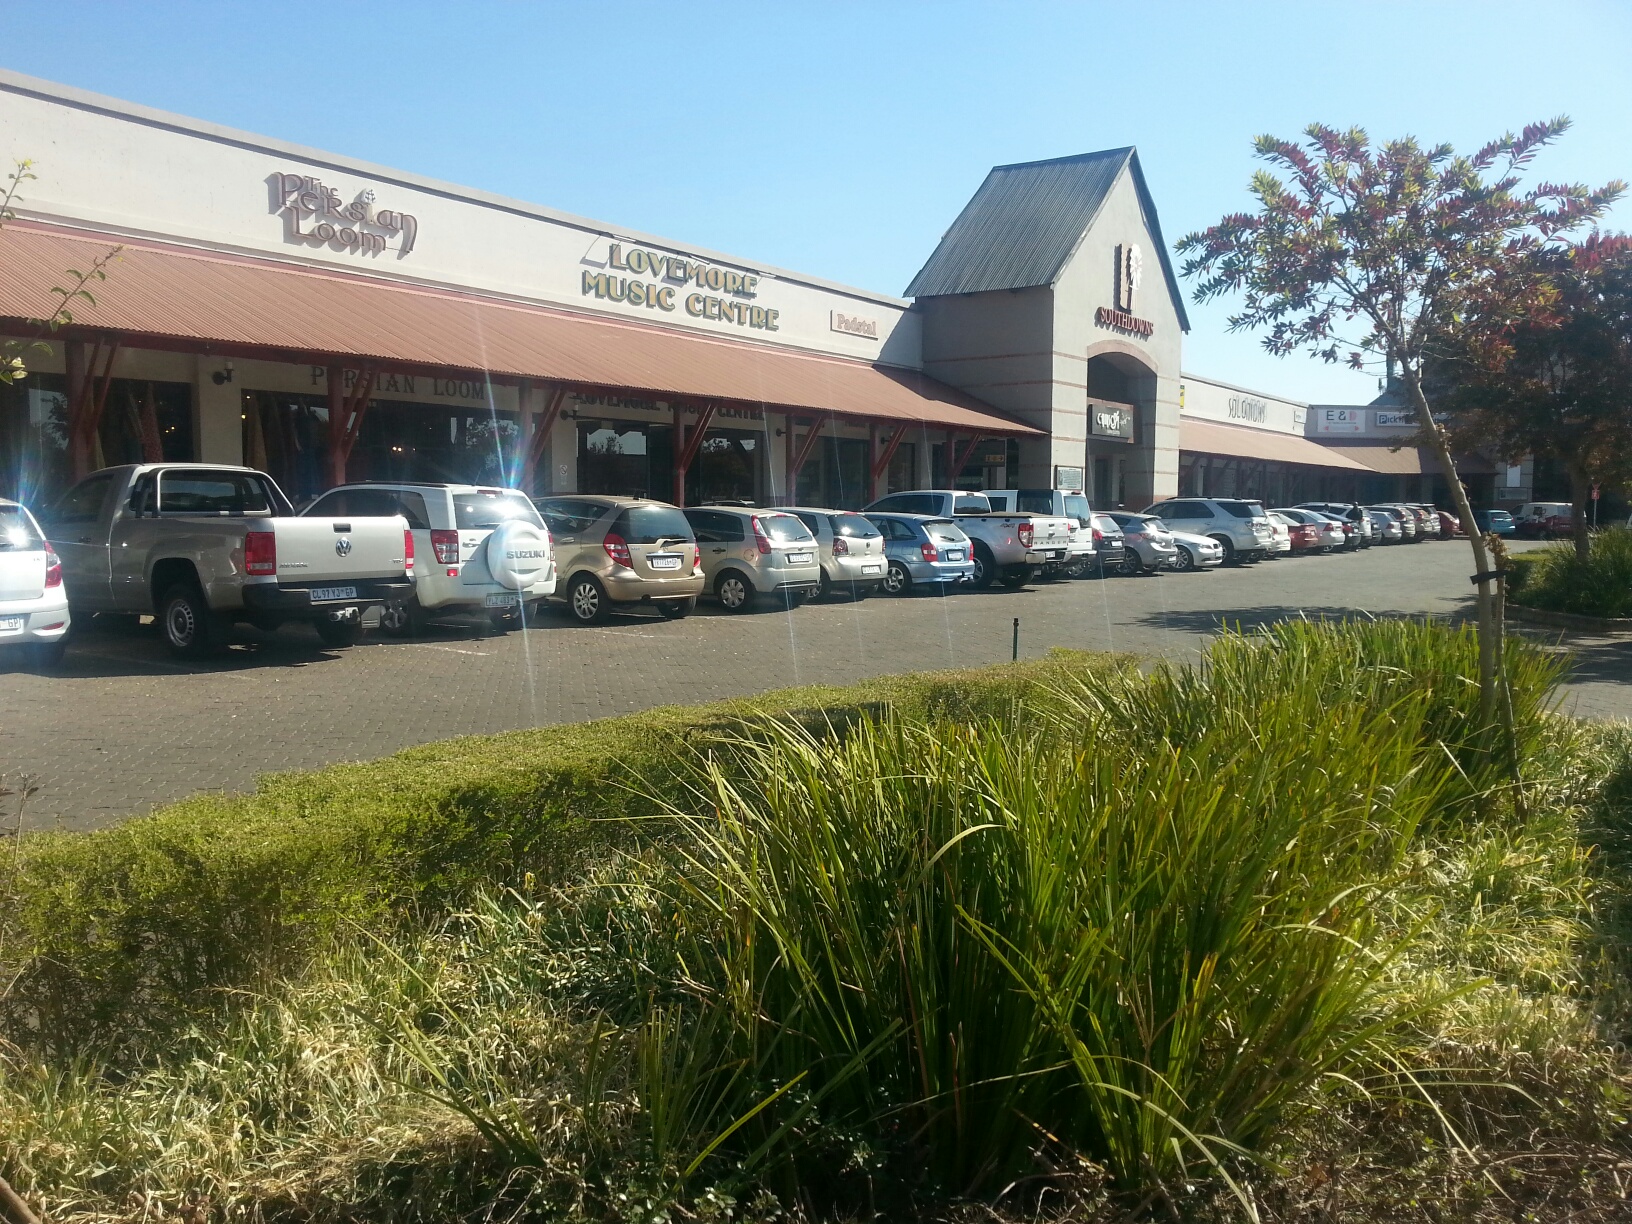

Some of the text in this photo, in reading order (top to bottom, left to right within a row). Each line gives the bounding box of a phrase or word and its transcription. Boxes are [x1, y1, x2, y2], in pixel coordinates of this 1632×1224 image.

[303, 175, 338, 197] The
[285, 205, 386, 251] Loom
[609, 244, 758, 297] LOVEMORE
[582, 270, 780, 331] MUSIC CENTRE
[836, 313, 877, 336] Padstal
[1099, 306, 1154, 336] SOUTHDOWNS
[433, 378, 484, 400] LOOM
[1326, 410, 1335, 421] E
[1338, 410, 1347, 421] &
[506, 550, 545, 559] SUZUKI
